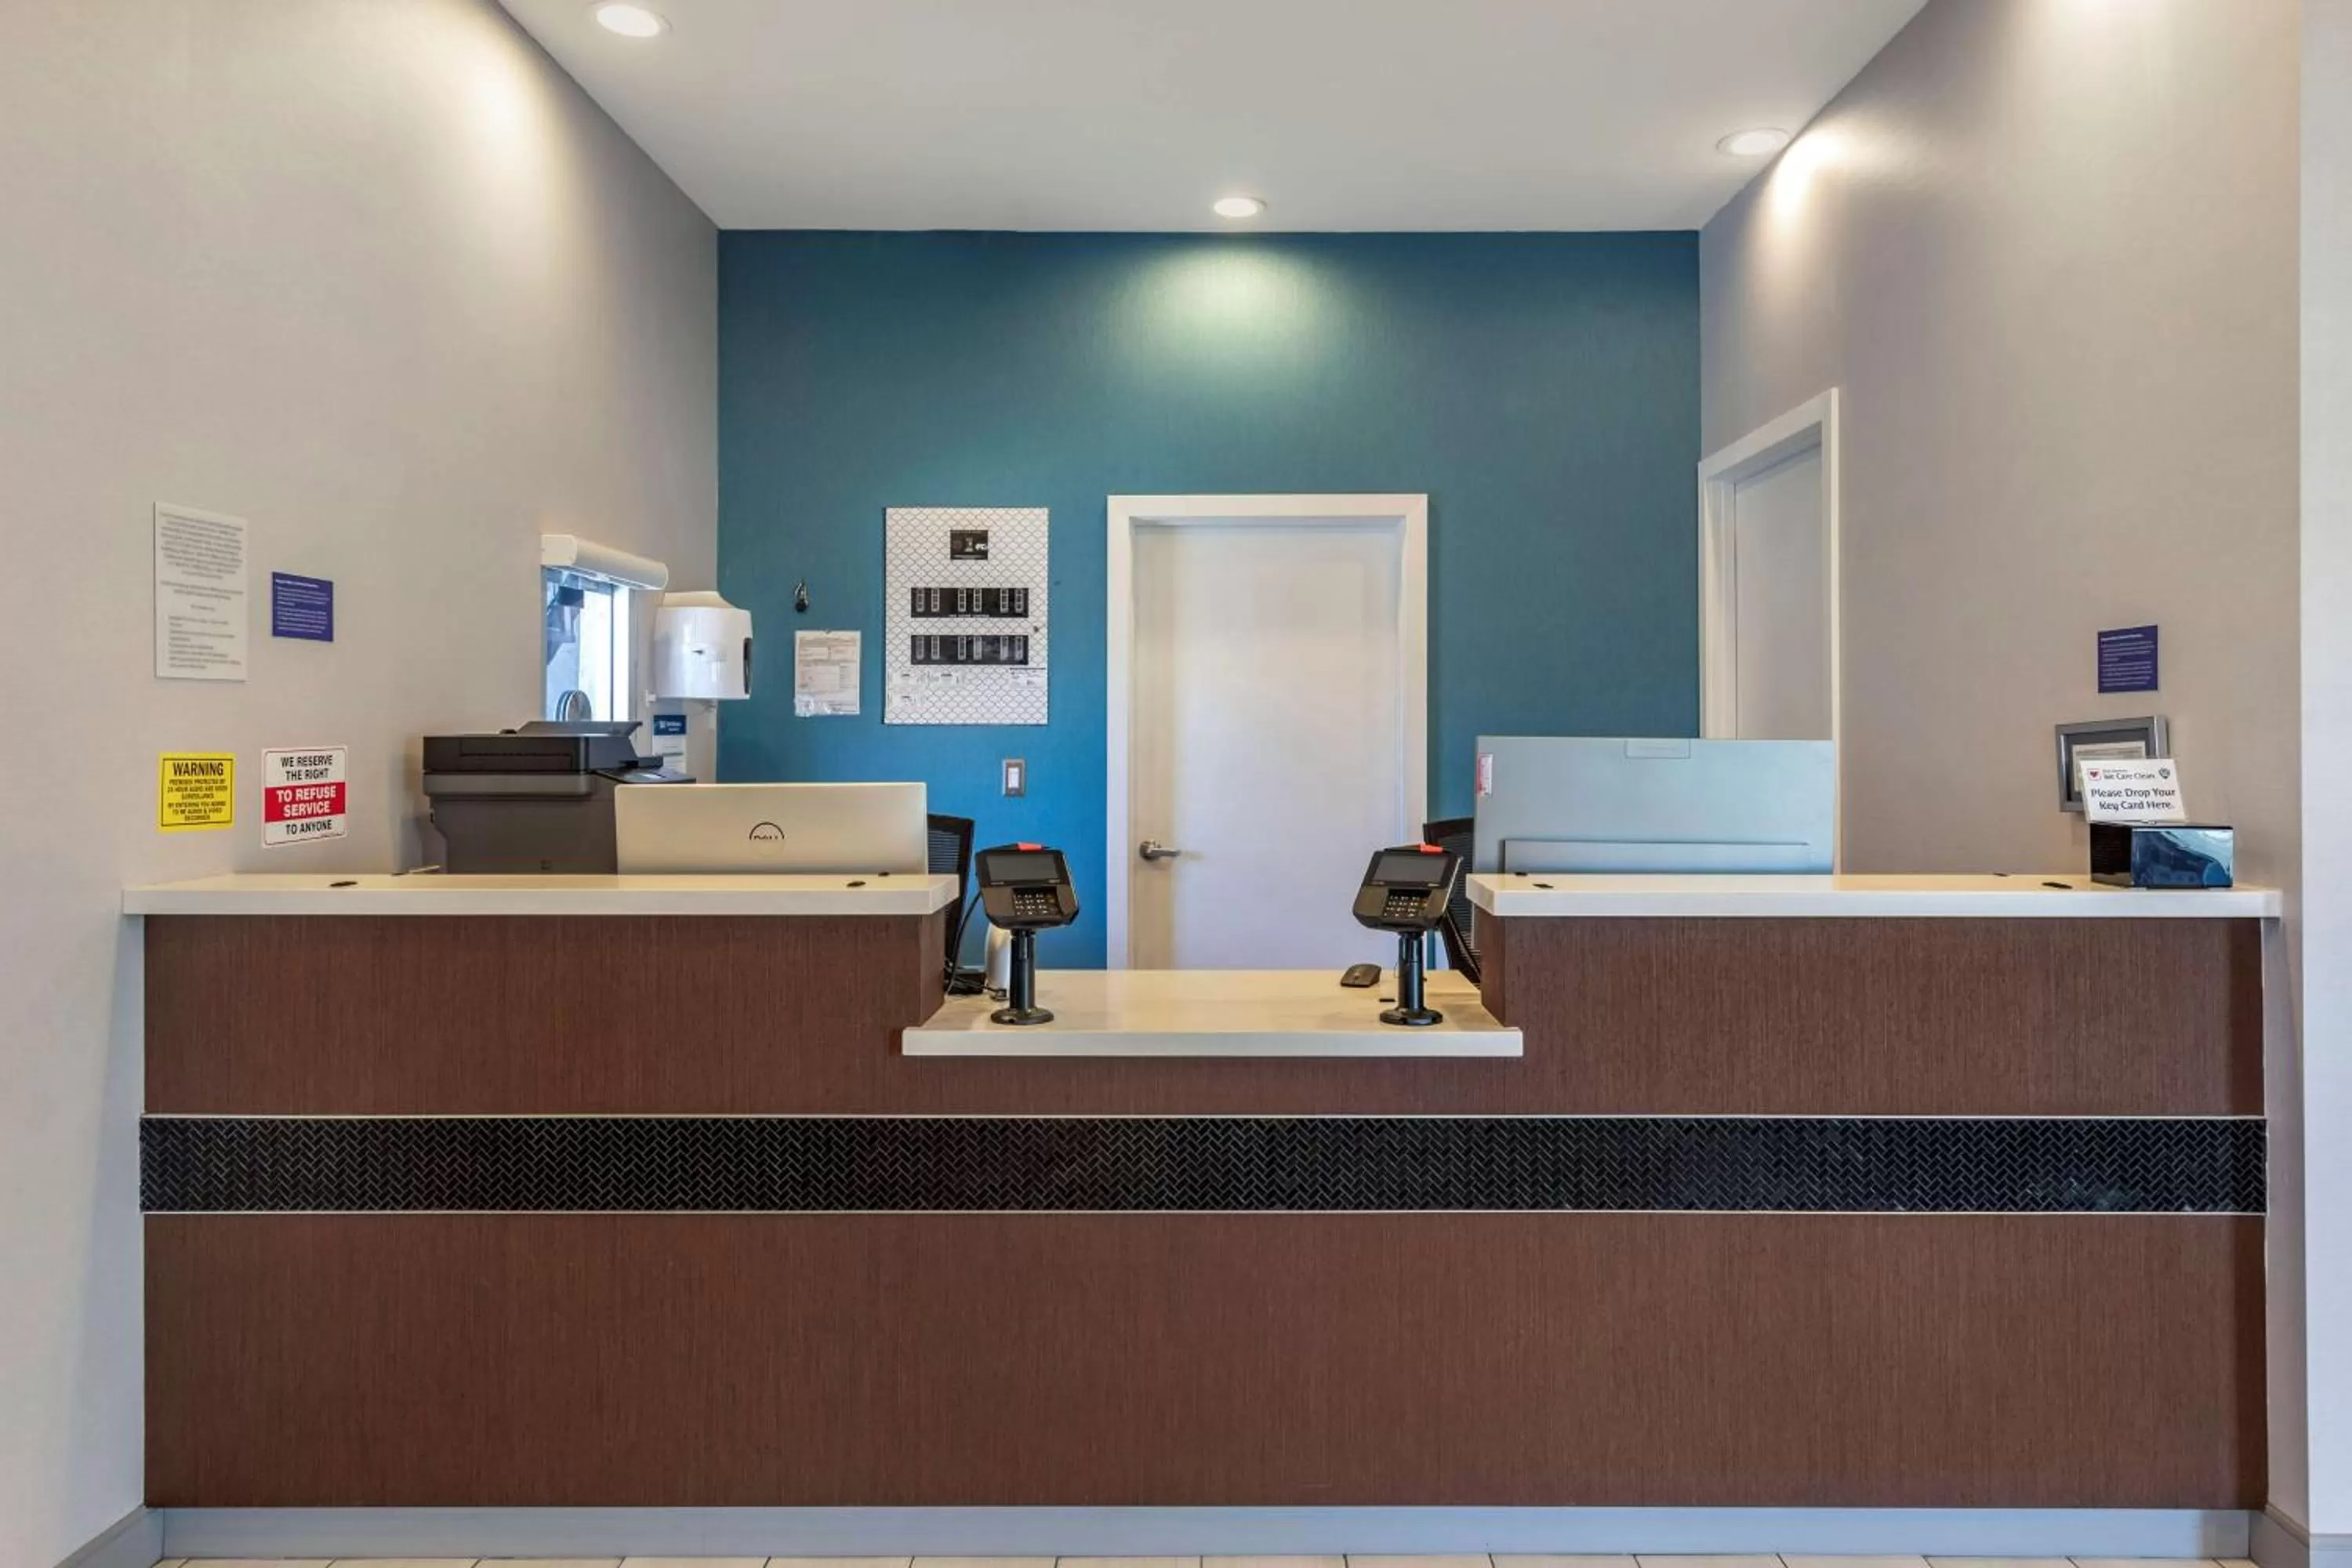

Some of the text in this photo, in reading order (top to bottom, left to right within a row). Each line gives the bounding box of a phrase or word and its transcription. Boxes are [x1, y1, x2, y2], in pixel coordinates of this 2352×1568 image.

[173, 761, 223, 776] WARNING
[281, 755, 332, 768] WE RESERVE
[285, 768, 329, 781] THE RIGHT
[276, 786, 336, 803] TO REFUSE
[2091, 787, 2176, 798] Please Drop Your
[283, 800, 331, 817] SERVICE
[2099, 800, 2119, 811] Key
[2121, 800, 2144, 810] Card
[285, 820, 332, 835] TO ANYONE
